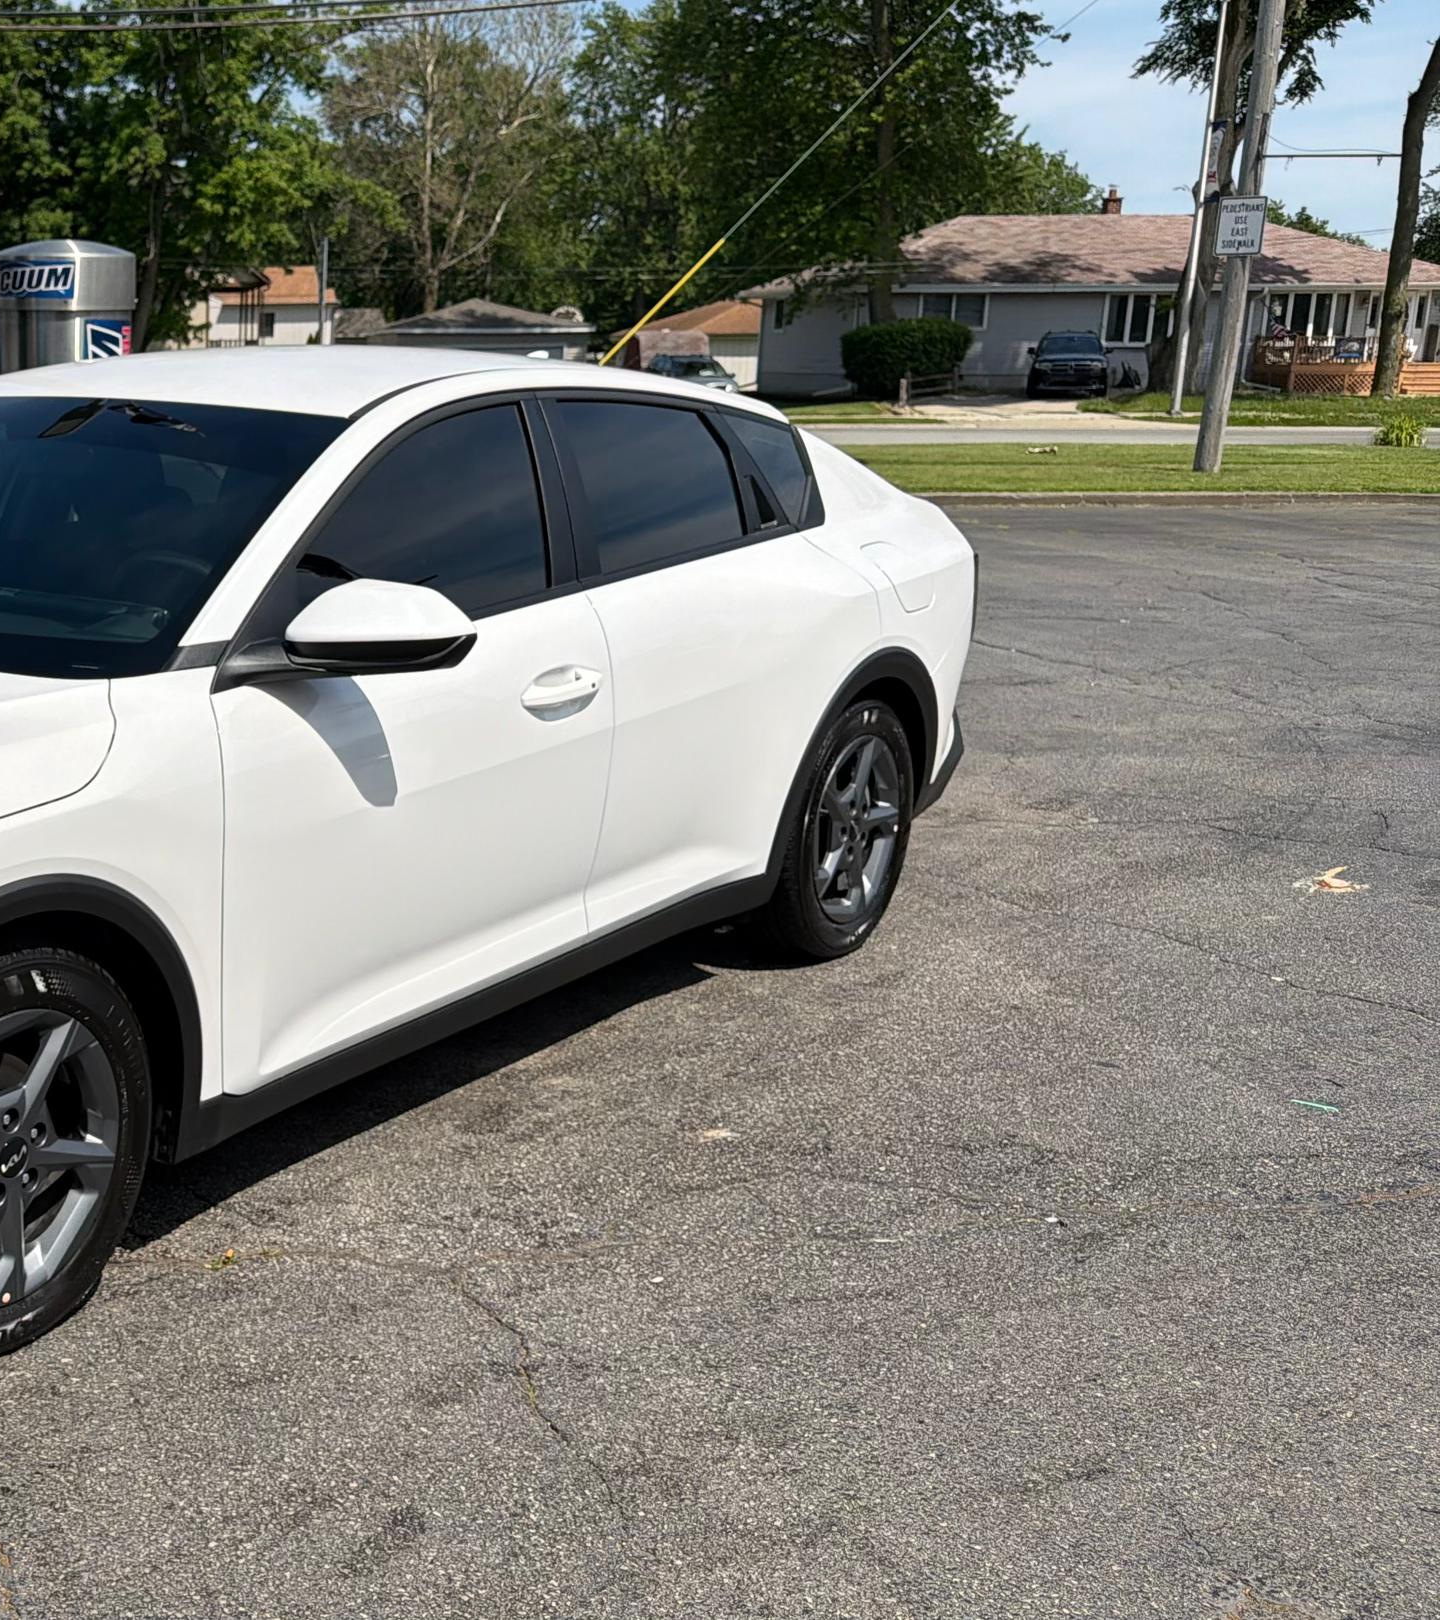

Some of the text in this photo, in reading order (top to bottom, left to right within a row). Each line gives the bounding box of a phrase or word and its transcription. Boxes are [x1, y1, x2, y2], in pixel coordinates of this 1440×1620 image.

[1222, 203, 1264, 213] PEDESTRIANS
[1235, 216, 1248, 225] USE
[1231, 227, 1248, 237] EAST
[1221, 239, 1254, 249] SIDEWALK
